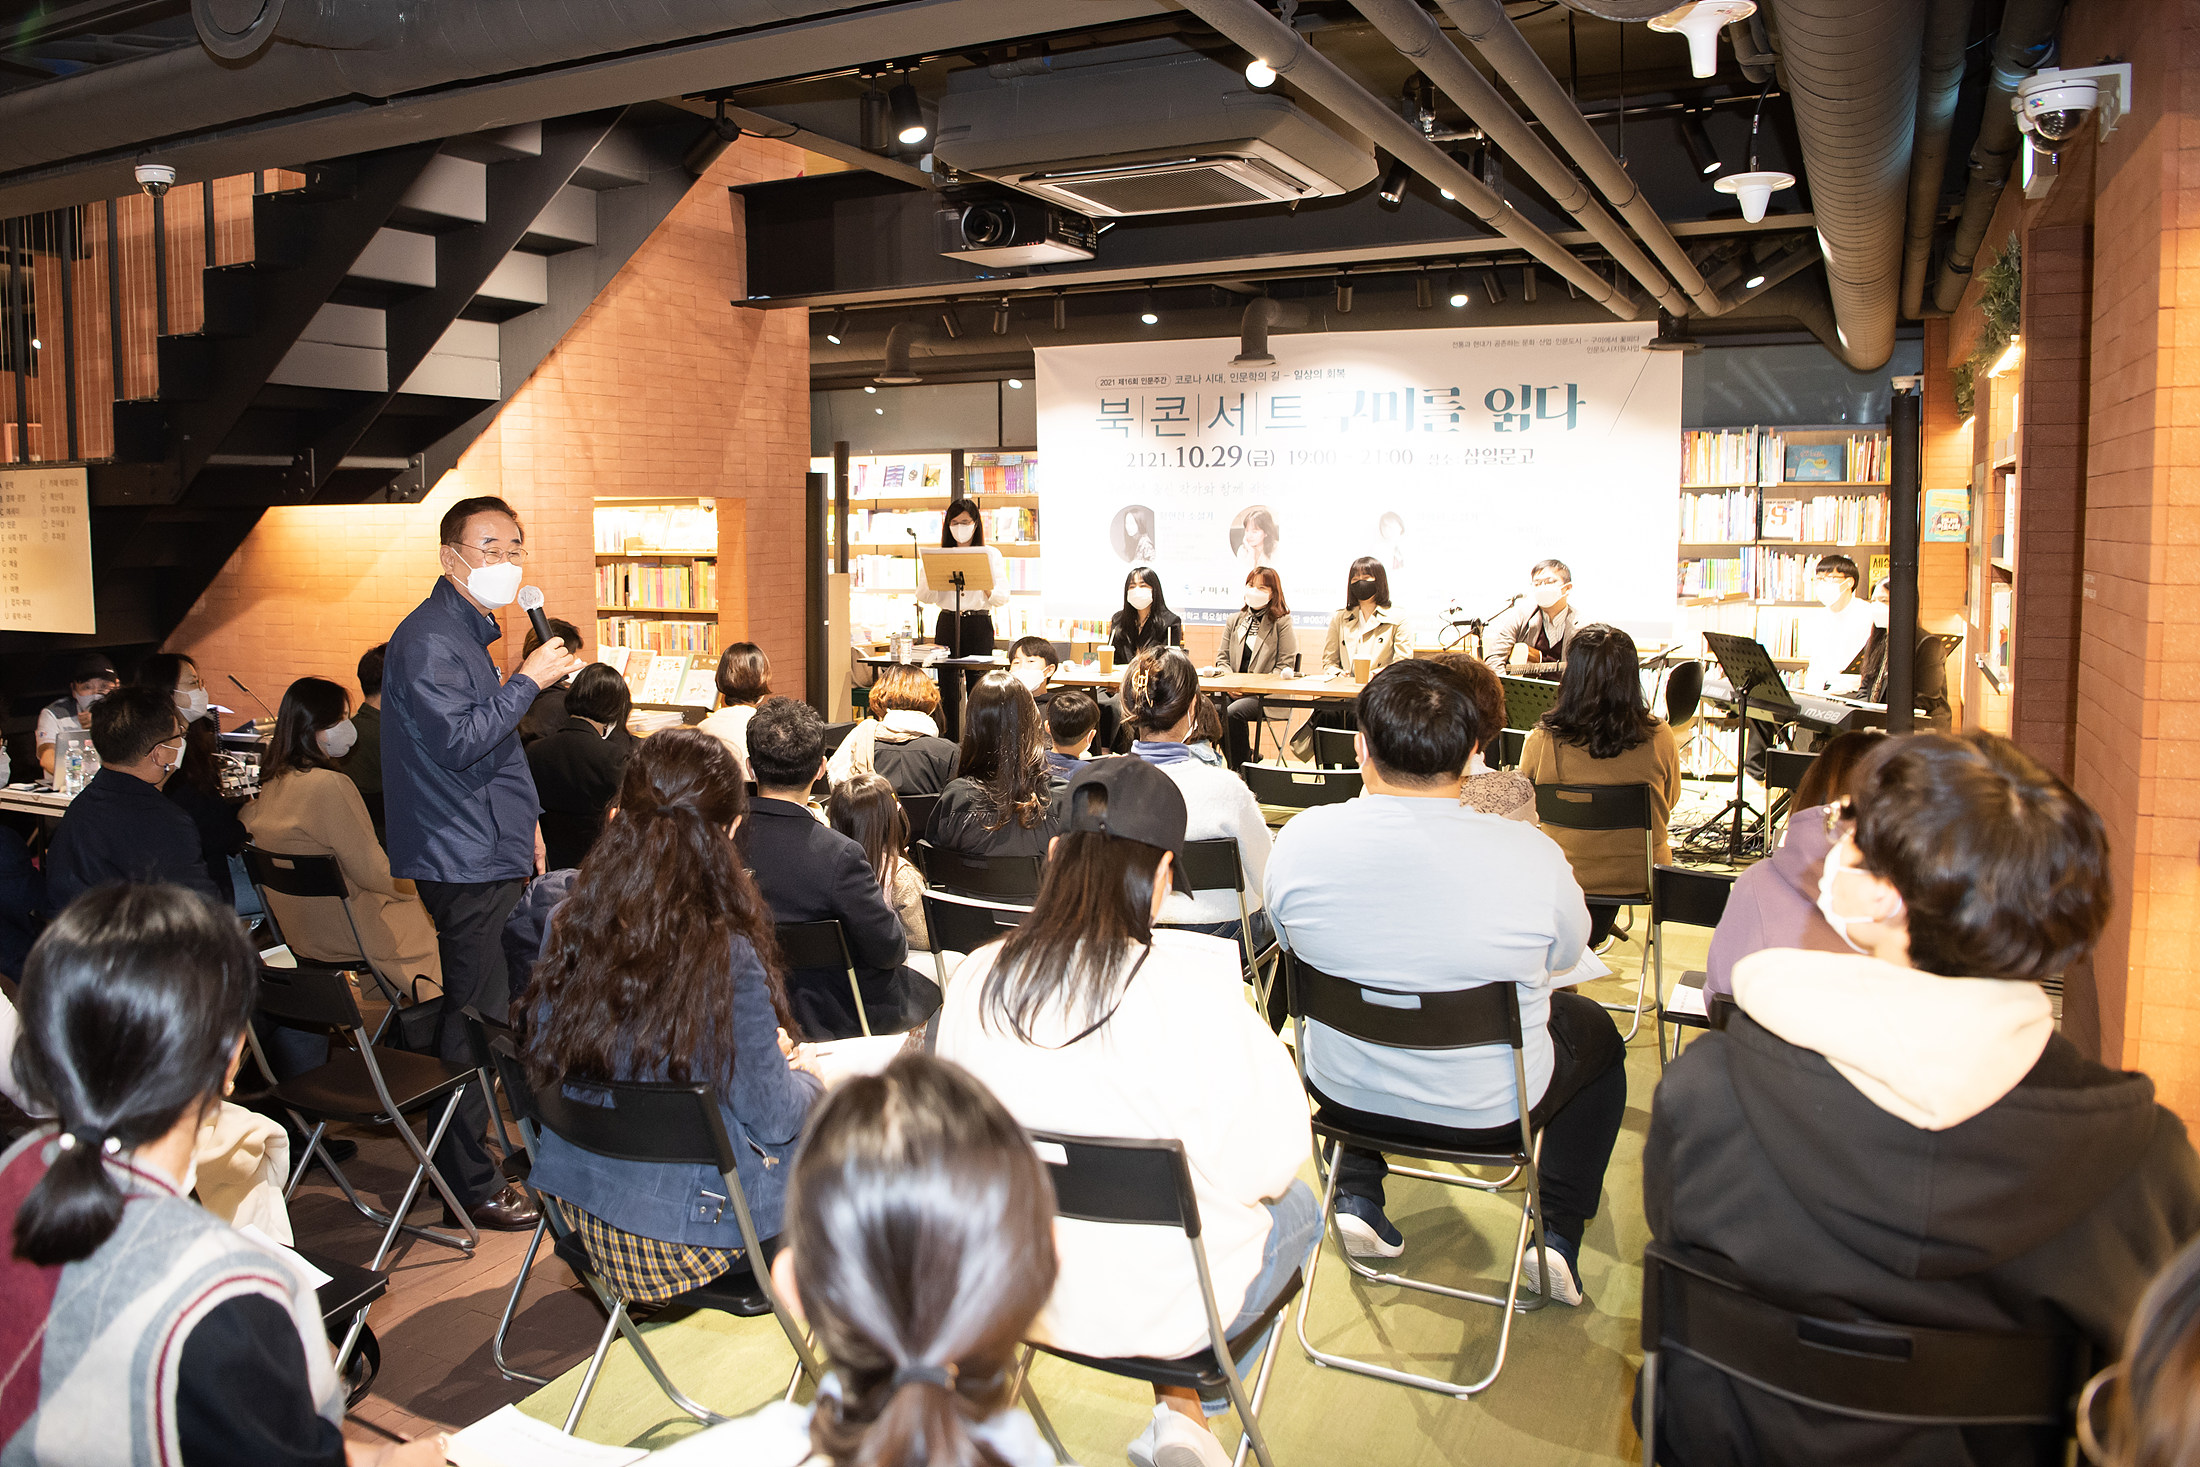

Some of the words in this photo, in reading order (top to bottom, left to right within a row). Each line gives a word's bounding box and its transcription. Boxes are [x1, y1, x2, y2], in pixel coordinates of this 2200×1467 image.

[1118, 378, 1139, 386] 제16회
[1141, 376, 1167, 386] 인문주간
[1175, 374, 1202, 385] 코로나
[1205, 373, 1226, 384] 시대,
[1230, 371, 1267, 384] 인문학의
[1271, 371, 1280, 382] 길
[1294, 369, 1323, 381] 일상의
[1327, 368, 1346, 379] 회복
[1484, 383, 1587, 433] 읽다
[1464, 448, 1535, 465] 삼일문고
